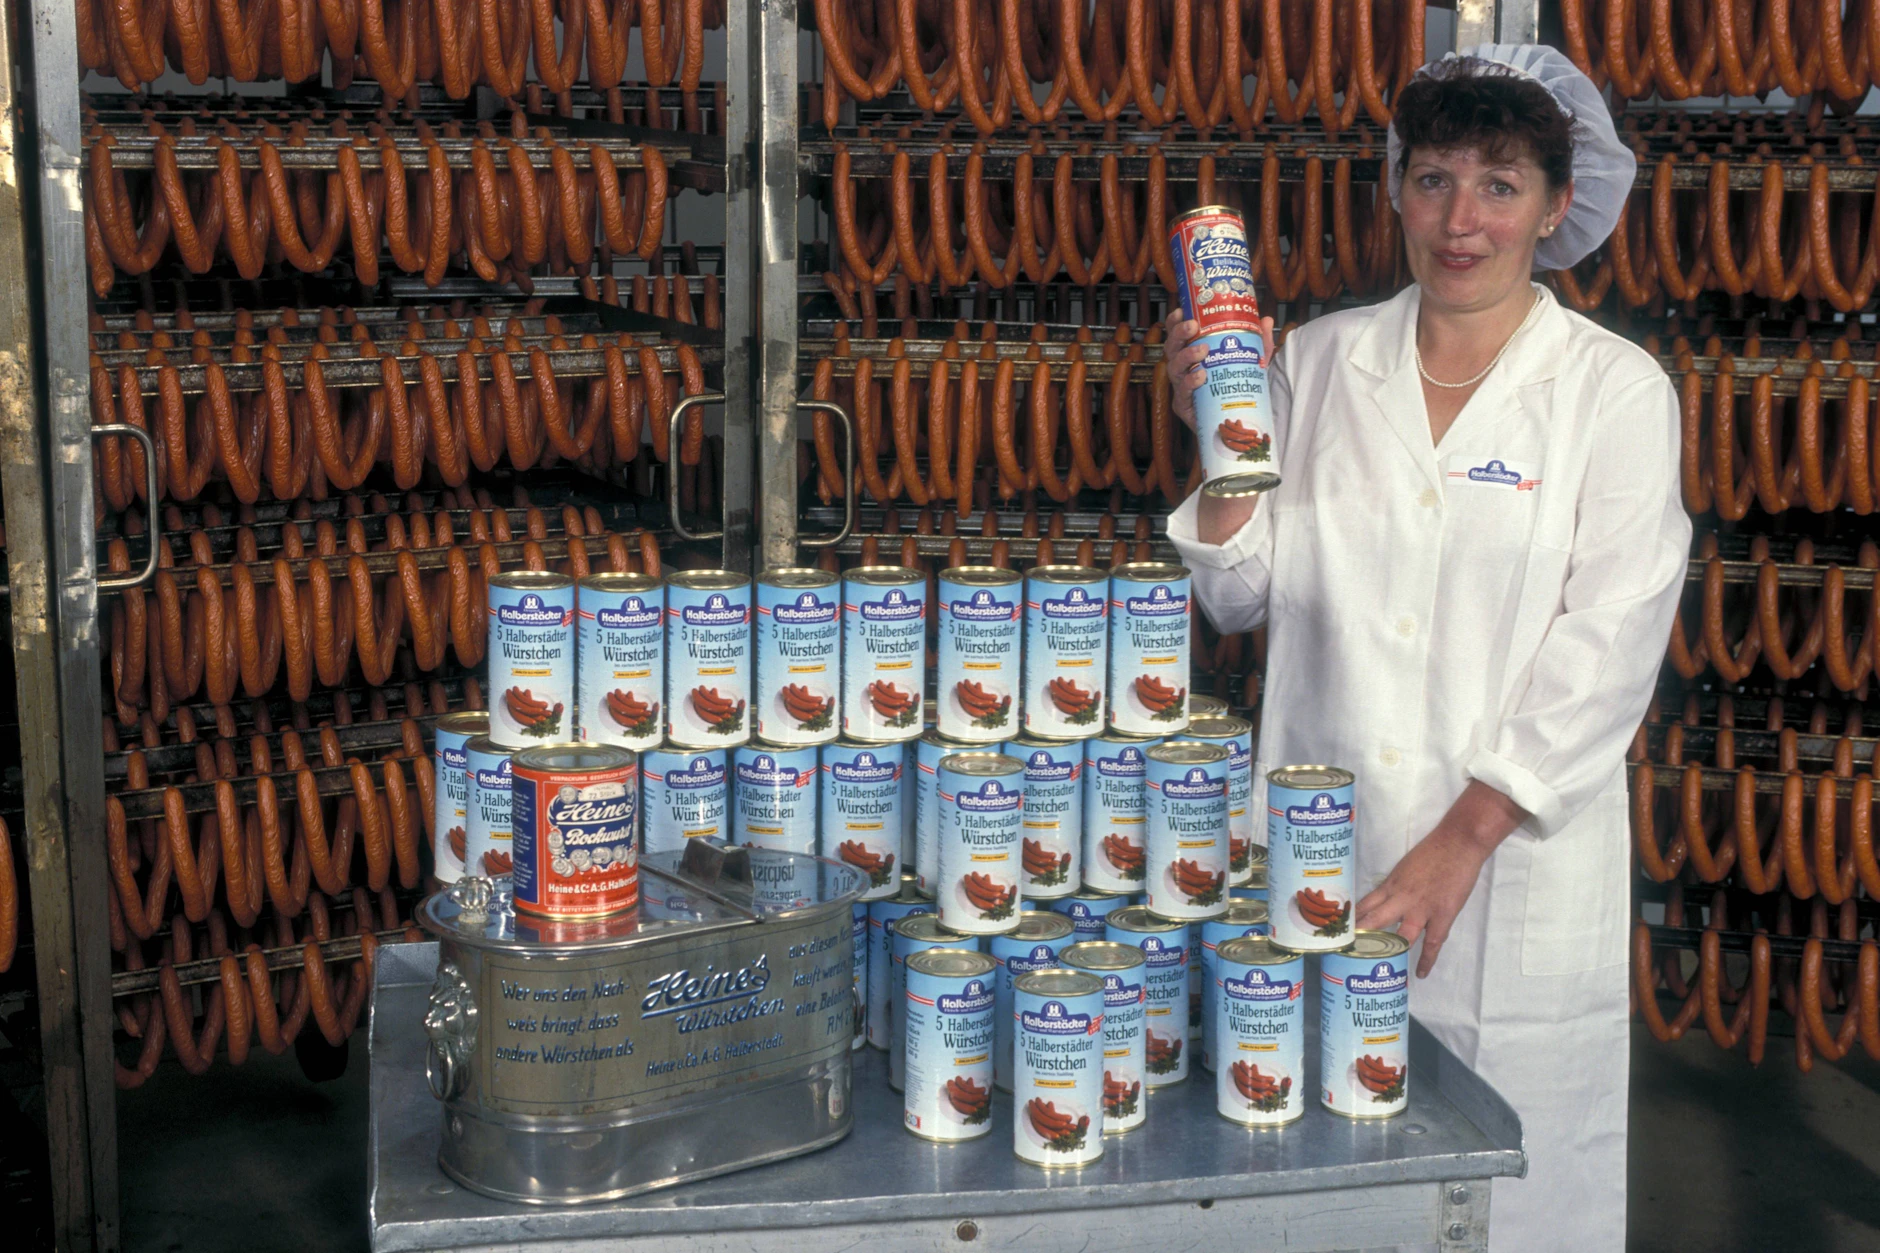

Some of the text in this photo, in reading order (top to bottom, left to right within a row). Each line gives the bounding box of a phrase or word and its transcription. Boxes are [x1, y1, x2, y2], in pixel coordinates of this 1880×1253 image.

[1202, 304, 1233, 316] Heine
[1209, 379, 1263, 397] Würstchen
[501, 608, 562, 620] Halberstädter
[686, 608, 744, 620] Halberstädter
[777, 606, 834, 619] Halberstädter
[864, 604, 920, 616] Halberstädter
[953, 603, 1013, 615] Halberstädter
[1046, 602, 1103, 613] Halberstädter
[1130, 600, 1186, 612] Halberstädter
[601, 610, 660, 623] Halberstädter
[1125, 616, 1132, 631] 5
[771, 624, 838, 641] 5 Halberstädter
[859, 621, 866, 636] 5
[949, 619, 1015, 637] 5 Halberstädter
[1040, 618, 1047, 633] 5
[496, 626, 567, 643] 5 Halberstädter
[596, 628, 663, 645] 5 Halberstädter
[681, 625, 748, 643] 5 Halberstädter
[1132, 633, 1185, 649] Würstchen
[502, 642, 561, 659] Würstchen
[688, 643, 744, 659] Würstchen
[778, 641, 834, 657] Würstchen
[866, 638, 920, 654] Würstchen
[955, 637, 1010, 653] Würstchen
[1047, 635, 1101, 651] Würstchen
[603, 646, 659, 661] Würstchen
[669, 769, 725, 784] Halberstädter
[738, 766, 795, 782] Halberstädter
[835, 765, 894, 778] Halberstädter
[736, 783, 741, 797] 5
[831, 781, 898, 798] 5 Halberstädter
[1023, 784, 1075, 798] alberstädter
[1095, 776, 1102, 790] 5
[1165, 782, 1224, 794] Halberstädter
[475, 789, 481, 804] 5
[664, 790, 671, 804] 5
[960, 794, 1019, 807] Halberstädter
[836, 798, 893, 815] Würstchen
[1023, 799, 1069, 813] ürstchen
[1161, 799, 1167, 814] 5
[954, 811, 961, 826] 5
[1290, 808, 1349, 821] Halberstädter
[1168, 816, 1224, 832] Würstchen
[564, 823, 632, 846] Bockwurst
[961, 829, 1017, 845] Würstchen
[1285, 826, 1292, 842] 5
[1292, 843, 1350, 861] Würstchen
[548, 883, 573, 893] Heine
[788, 935, 839, 960] aus diesem
[641, 953, 771, 1012] Heine's
[793, 965, 821, 989] kauft
[1005, 974, 1012, 990] 5
[1350, 975, 1407, 989] Halberstädter
[501, 977, 630, 1003] Wer uns den Nach-
[1146, 985, 1181, 1000] stchen
[1227, 981, 1289, 995] Halberstädter
[795, 999, 818, 1018] eine
[1223, 997, 1295, 1018] 5 Halberstädter
[1344, 994, 1352, 1010] 5
[506, 1015, 537, 1033] weis
[588, 1010, 620, 1031] dass
[675, 995, 786, 1035] Würstchen
[936, 1015, 943, 1031] 5
[1024, 1015, 1088, 1029] Halberstädter
[1229, 1015, 1288, 1035] Würstchen
[1020, 1031, 1026, 1047] 5
[1028, 1035, 1093, 1053] Halberstädter
[495, 1037, 635, 1065] andere Würstchen als
[1025, 1050, 1087, 1070] Würstchen
[645, 1059, 675, 1078] Heine
